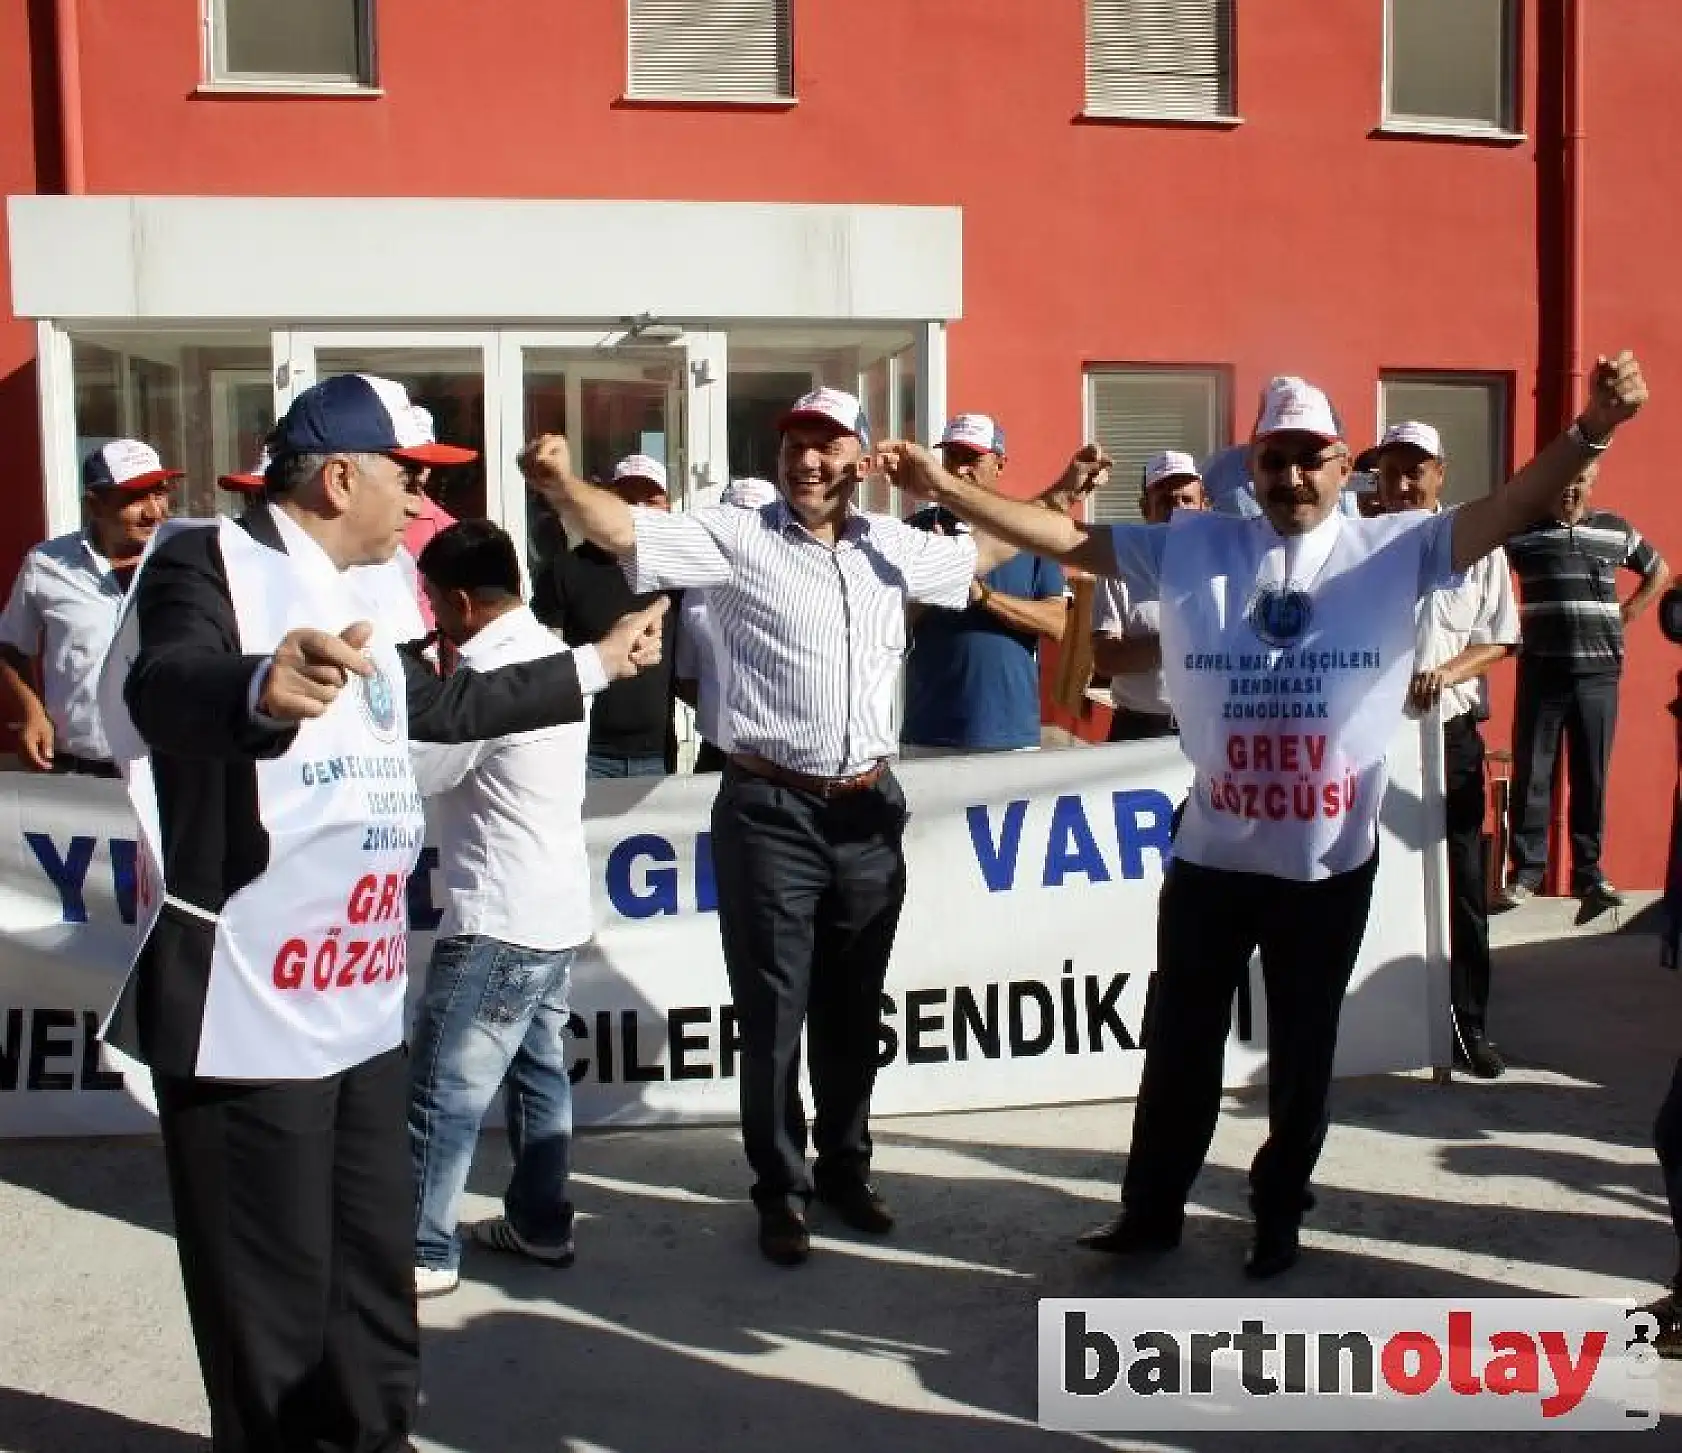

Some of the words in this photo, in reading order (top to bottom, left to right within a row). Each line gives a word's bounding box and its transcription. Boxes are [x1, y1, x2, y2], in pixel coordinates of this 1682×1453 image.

[1227, 733, 1327, 772] GREV
[965, 789, 1174, 892] VAR
[347, 872, 407, 925] GR
[273, 926, 407, 992] GÖZCÜ
